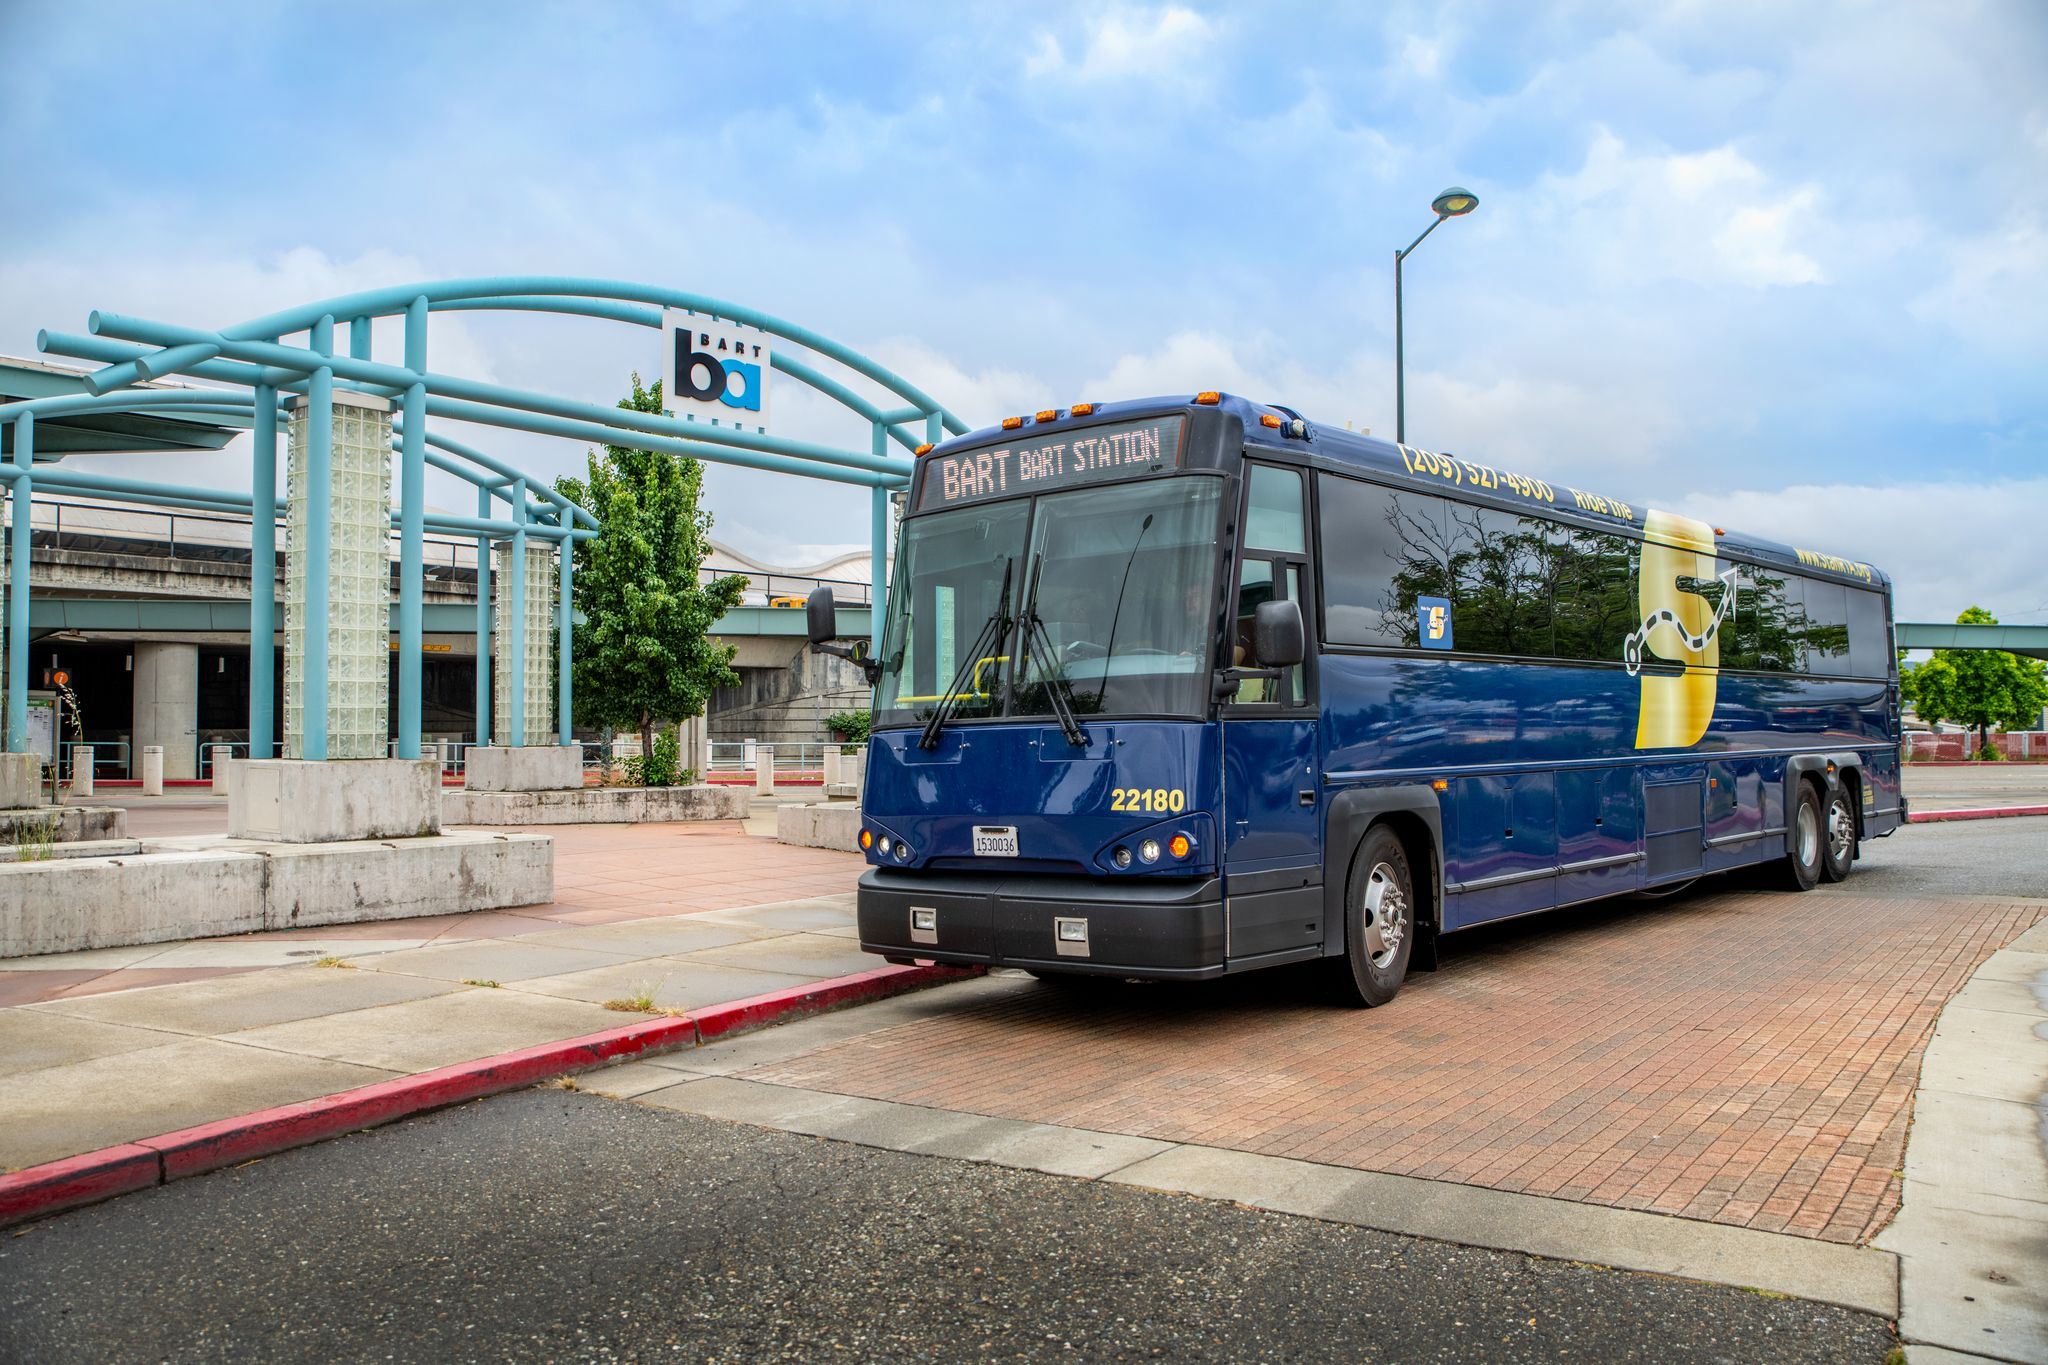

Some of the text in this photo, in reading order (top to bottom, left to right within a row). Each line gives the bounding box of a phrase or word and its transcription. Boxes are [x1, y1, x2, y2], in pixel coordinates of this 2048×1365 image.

[701, 333, 761, 357] BART
[943, 427, 1160, 500] BART BART STATION
[1397, 443, 1462, 486] (209)
[1110, 788, 1185, 812] 22180
[976, 837, 1015, 852] 1530036
